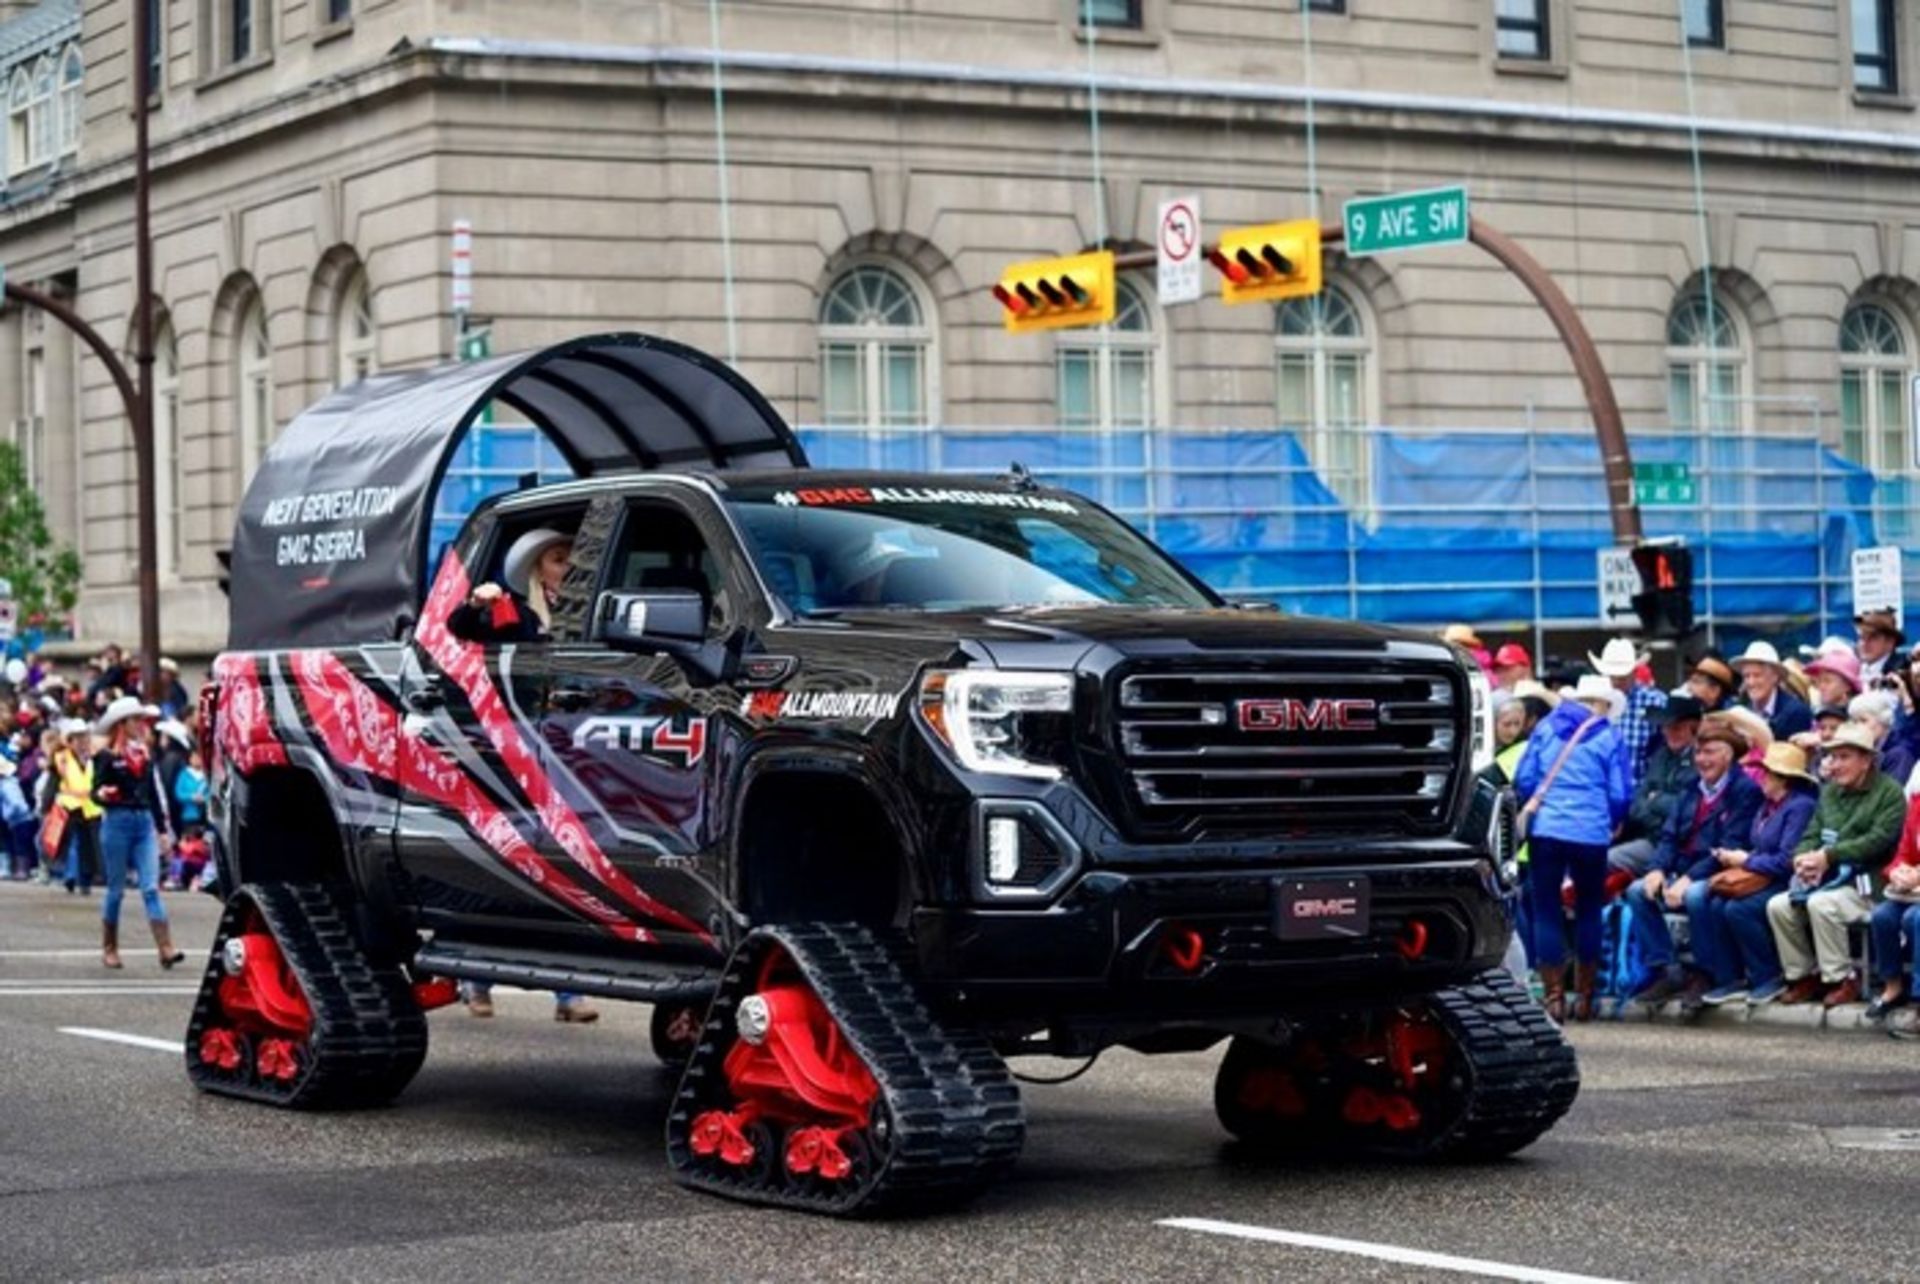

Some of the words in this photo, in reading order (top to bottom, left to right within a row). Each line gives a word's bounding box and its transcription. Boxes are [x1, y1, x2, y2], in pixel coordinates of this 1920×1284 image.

[1351, 213, 1367, 241] 9
[1378, 205, 1418, 239] AVE
[1428, 200, 1460, 234] SW
[261, 496, 304, 528] NEXT
[302, 486, 399, 522] GENERATION
[774, 487, 1079, 516] #GMCALLMOUNTAIN
[277, 534, 310, 566] GMC
[312, 529, 366, 563] SIERRA
[1604, 579, 1635, 594] WAY
[1235, 699, 1376, 731] GMC
[573, 716, 706, 767] AT4
[1293, 898, 1356, 917] GMC
